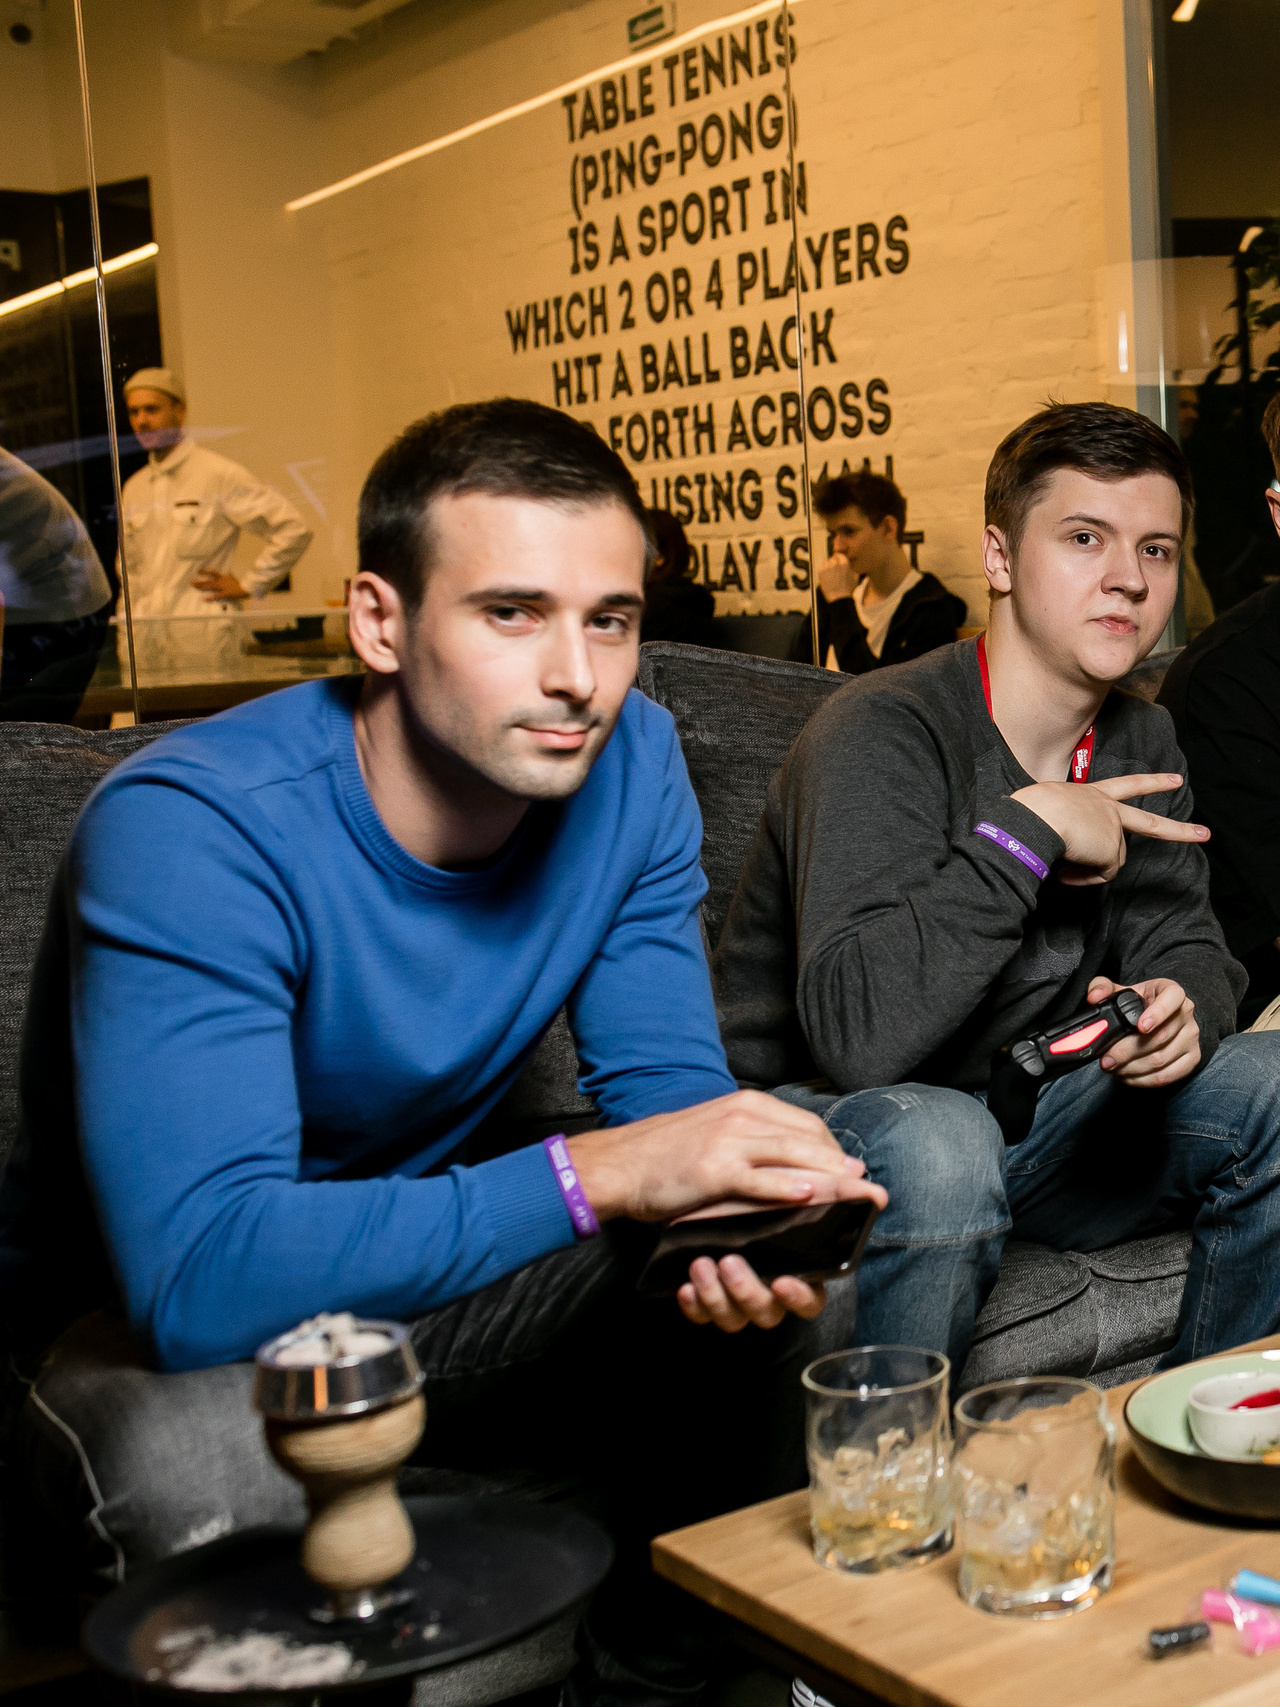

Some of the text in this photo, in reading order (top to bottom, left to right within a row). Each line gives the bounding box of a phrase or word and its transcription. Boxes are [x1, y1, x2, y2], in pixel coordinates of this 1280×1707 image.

[561, 11, 798, 142] TABLE TENNIS
[570, 93, 797, 221] (PING-PONG)
[568, 160, 808, 275] IS A SPORT IN
[505, 214, 909, 355] WHICH 2 OR 4 PLAYERS
[552, 307, 837, 407] HIT A BALL BACK
[609, 378, 892, 462] FORTH ACROSS
[651, 468, 764, 526] USING
[773, 536, 811, 592] IS
